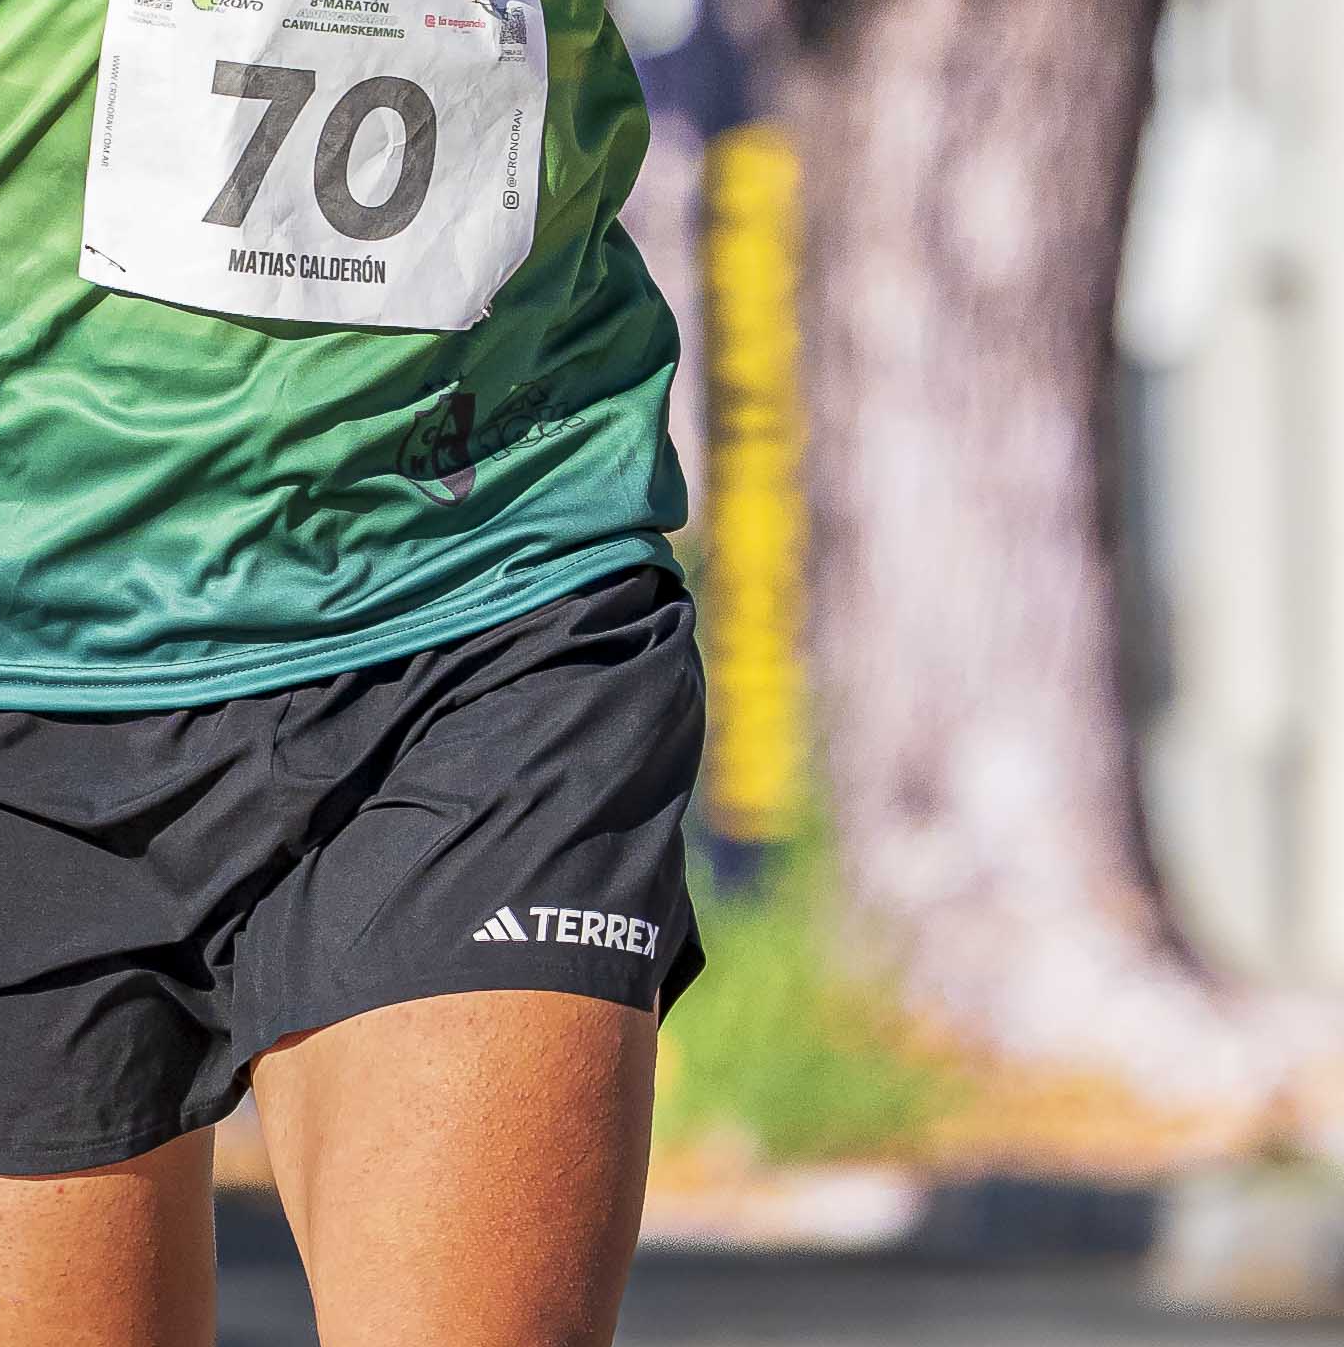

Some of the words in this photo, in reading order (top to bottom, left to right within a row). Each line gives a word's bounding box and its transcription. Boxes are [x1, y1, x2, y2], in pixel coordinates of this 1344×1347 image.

[282, 18, 406, 39] CAWILLIAMSKEMMIS
[201, 60, 437, 242] 70
[506, 108, 524, 188] @CRONORAV
[228, 248, 297, 278] MATIAS
[299, 254, 387, 285] CALDERÓN
[529, 905, 660, 960] TERREX
